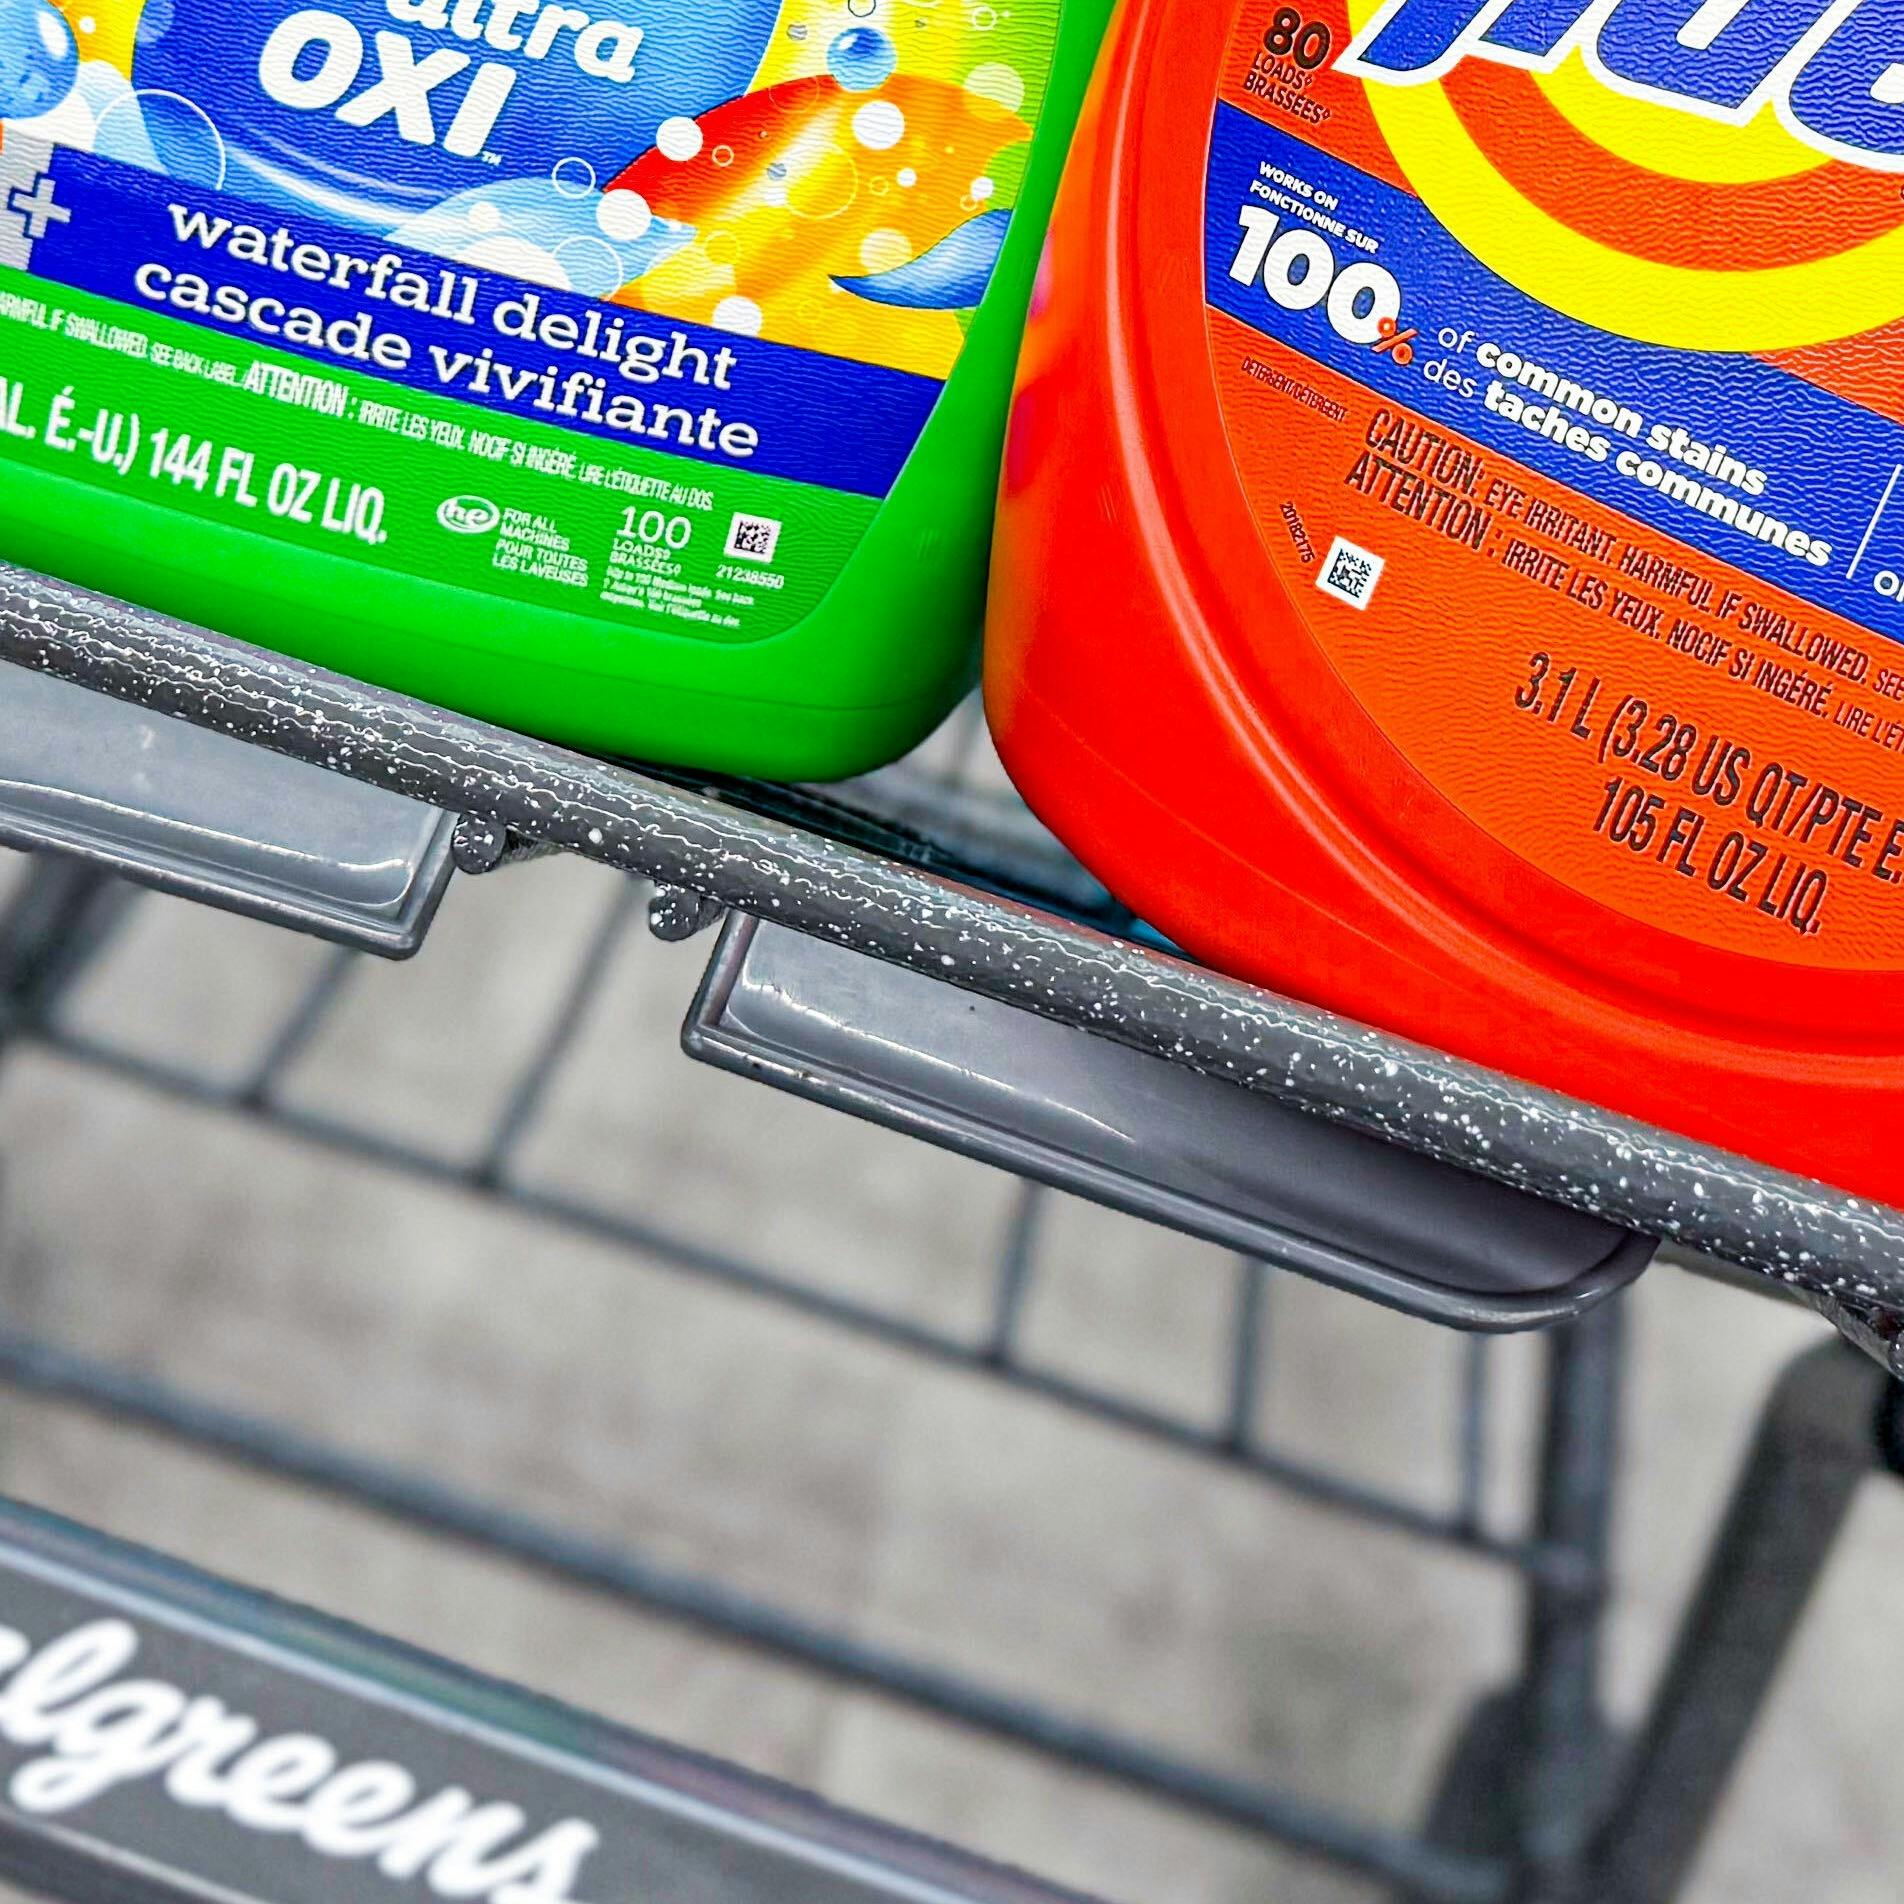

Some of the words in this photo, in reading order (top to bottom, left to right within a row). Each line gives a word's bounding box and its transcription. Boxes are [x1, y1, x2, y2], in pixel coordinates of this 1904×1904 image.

[258, 9, 517, 157] OXI
[1262, 6, 1332, 70] 80
[1249, 179, 1346, 237] FONCTIONNE
[1344, 228, 1380, 254] SUR
[1259, 160, 1313, 198] WORKS
[1313, 190, 1339, 211] ON
[134, 261, 411, 371] cascade
[428, 341, 760, 458] vivifiante
[167, 203, 477, 325] waterfall
[493, 290, 738, 390] delight
[44, 385, 140, 476] É.-U.)
[149, 427, 213, 492] 144
[215, 446, 258, 508] FL
[267, 462, 322, 523] OZ
[321, 477, 388, 545] LIQ.
[1423, 358, 1478, 399] des
[1483, 379, 1611, 463] taches
[1615, 450, 1833, 566] communes
[1437, 325, 1475, 354] of
[1475, 342, 1644, 438] common
[1645, 423, 1768, 496] stains
[492, 552, 519, 571] LES
[520, 559, 589, 587] LAVEUSES
[496, 538, 534, 560] POUR
[536, 548, 589, 572] TOUTES
[499, 521, 571, 552] MACHINES
[503, 507, 531, 527] FOR
[532, 515, 557, 534] ALL
[616, 505, 692, 549] 100
[1364, 407, 1486, 498] CAUTION:
[1483, 478, 1527, 520] EYE
[1524, 496, 1619, 565] IRRITANT.
[1619, 543, 1718, 617] HARMFUL
[1714, 587, 1742, 624] IF
[1738, 602, 1870, 684] SWALLOWED.
[1501, 537, 1570, 590] IRRITE
[1566, 568, 1609, 610] LES
[1606, 587, 1664, 639] YEUX.
[1665, 617, 1733, 668] NOCIF
[1728, 647, 1754, 679] SI
[1751, 657, 1833, 717] INGÉRÉ.
[1833, 700, 1875, 739] LIRE
[1513, 651, 1577, 724] 3.1
[1570, 677, 1601, 740] L
[1597, 693, 1697, 783] (3.28
[1691, 734, 1752, 807] US
[1745, 761, 1882, 868] QT/PTE
[1592, 775, 1666, 852] 105
[1657, 806, 1707, 877] FL
[1707, 831, 1768, 902] OZ
[1756, 851, 1831, 936] LIQ.
